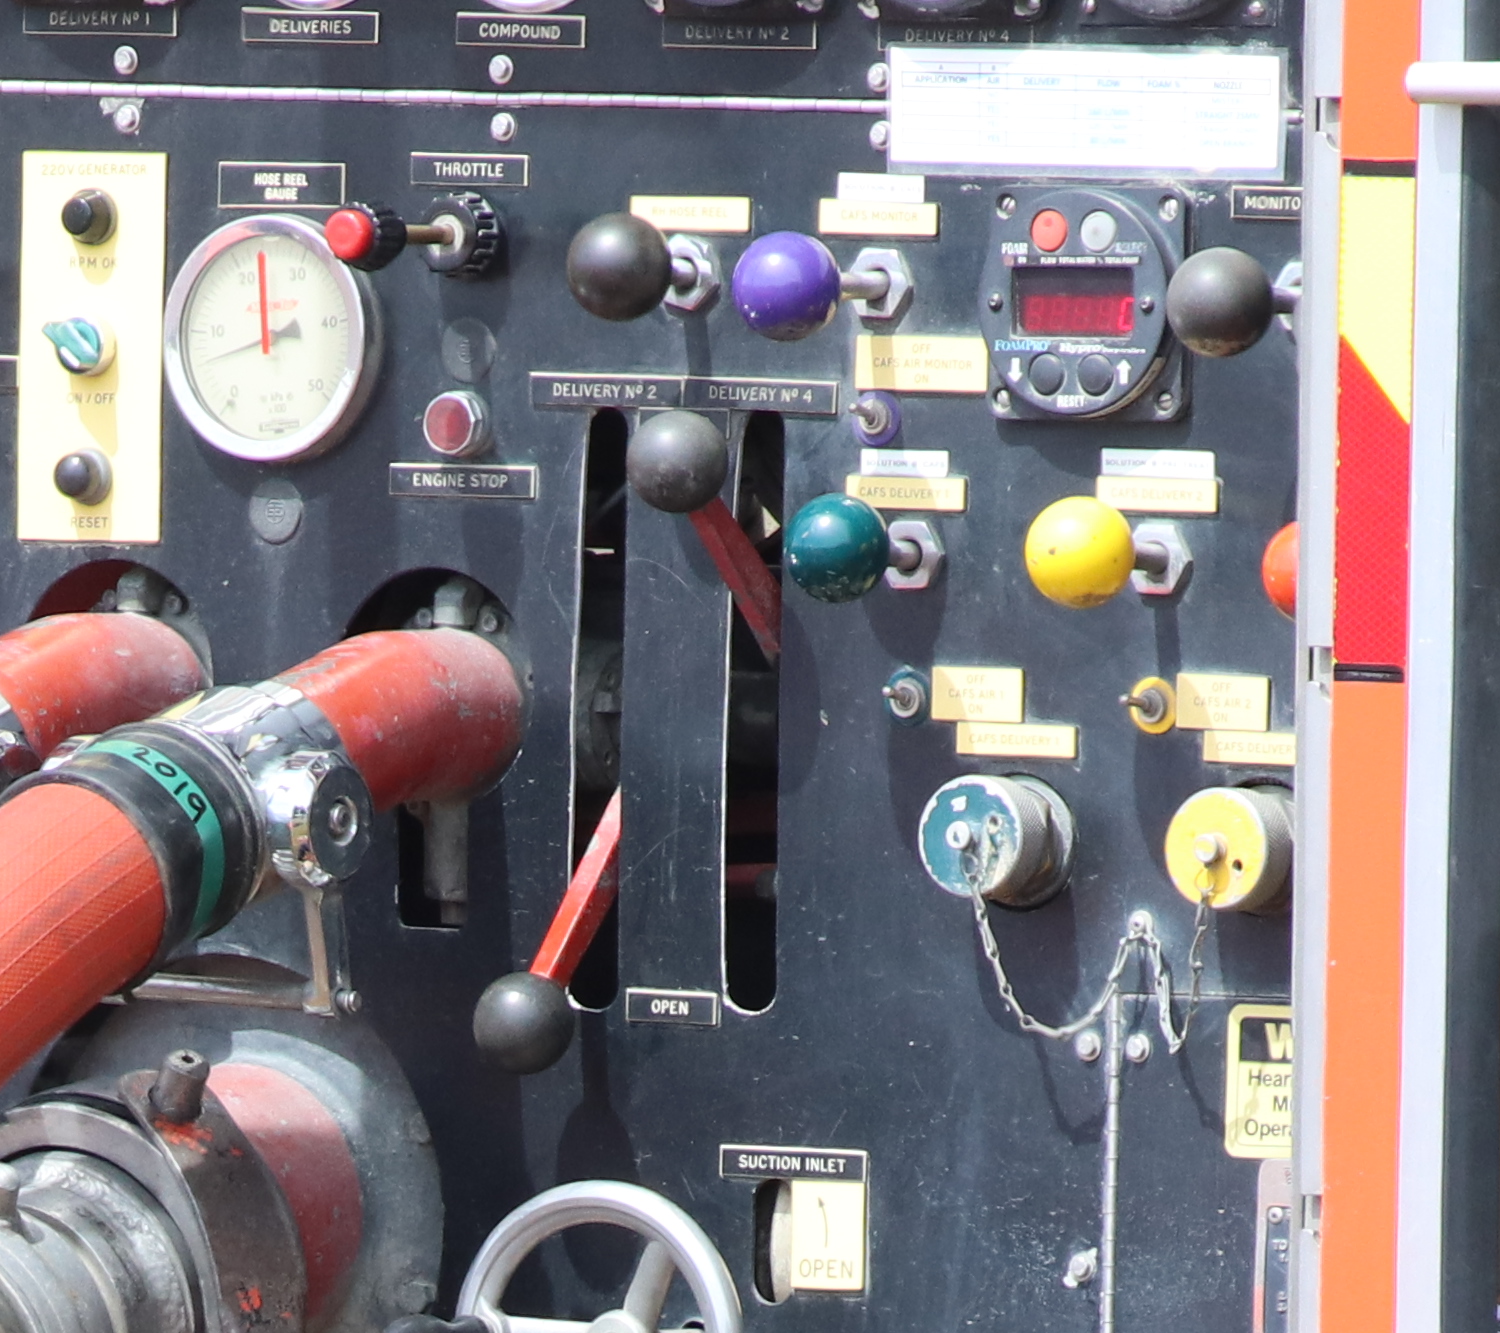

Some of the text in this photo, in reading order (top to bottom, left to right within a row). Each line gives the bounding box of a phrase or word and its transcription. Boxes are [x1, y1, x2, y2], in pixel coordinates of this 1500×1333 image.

[49, 10, 117, 26] DELIVERY
[268, 18, 352, 34] DELIVERIES
[478, 22, 561, 40] COMPOUND
[684, 25, 790, 41] DELIVERY 2
[904, 27, 1010, 43] DELIVERY 4
[914, 74, 968, 85] APPLICATION
[41, 164, 148, 177] 220V GENERATOR
[433, 161, 504, 178] THROTTLE
[253, 173, 309, 187] HOSE REEL
[264, 187, 298, 201] GAUGE
[668, 206, 728, 219] HOSE REEL
[840, 208, 918, 222] CAFS MONITOR
[69, 257, 118, 269] RPM OK
[238, 266, 307, 286] 20 30
[210, 315, 338, 338] 10 40
[911, 342, 932, 355] OFF
[873, 356, 973, 371] CAFS AIR MONITOR
[913, 373, 930, 384] ON
[229, 378, 324, 398] 0 50
[552, 382, 658, 400] DELIVERY 2
[708, 384, 814, 403] DELIVERY 4
[94, 393, 116, 405] OFF
[412, 472, 509, 489] ENGINE STOP
[858, 486, 940, 499] CAFS DELIVERY
[70, 516, 109, 529] RESET
[965, 674, 987, 685] OFF
[948, 688, 998, 700] CAFS AIR
[1211, 682, 1233, 693] OFF
[1192, 696, 1252, 708] CAFS AIR 2
[968, 704, 984, 715] ON
[1212, 711, 1229, 723] ON
[1216, 741, 1246, 753] CAFS
[131, 746, 208, 824] 2019
[650, 998, 690, 1017] OPEN
[737, 1154, 847, 1173] SUCTION INLET
[799, 1258, 854, 1280] OPEN
